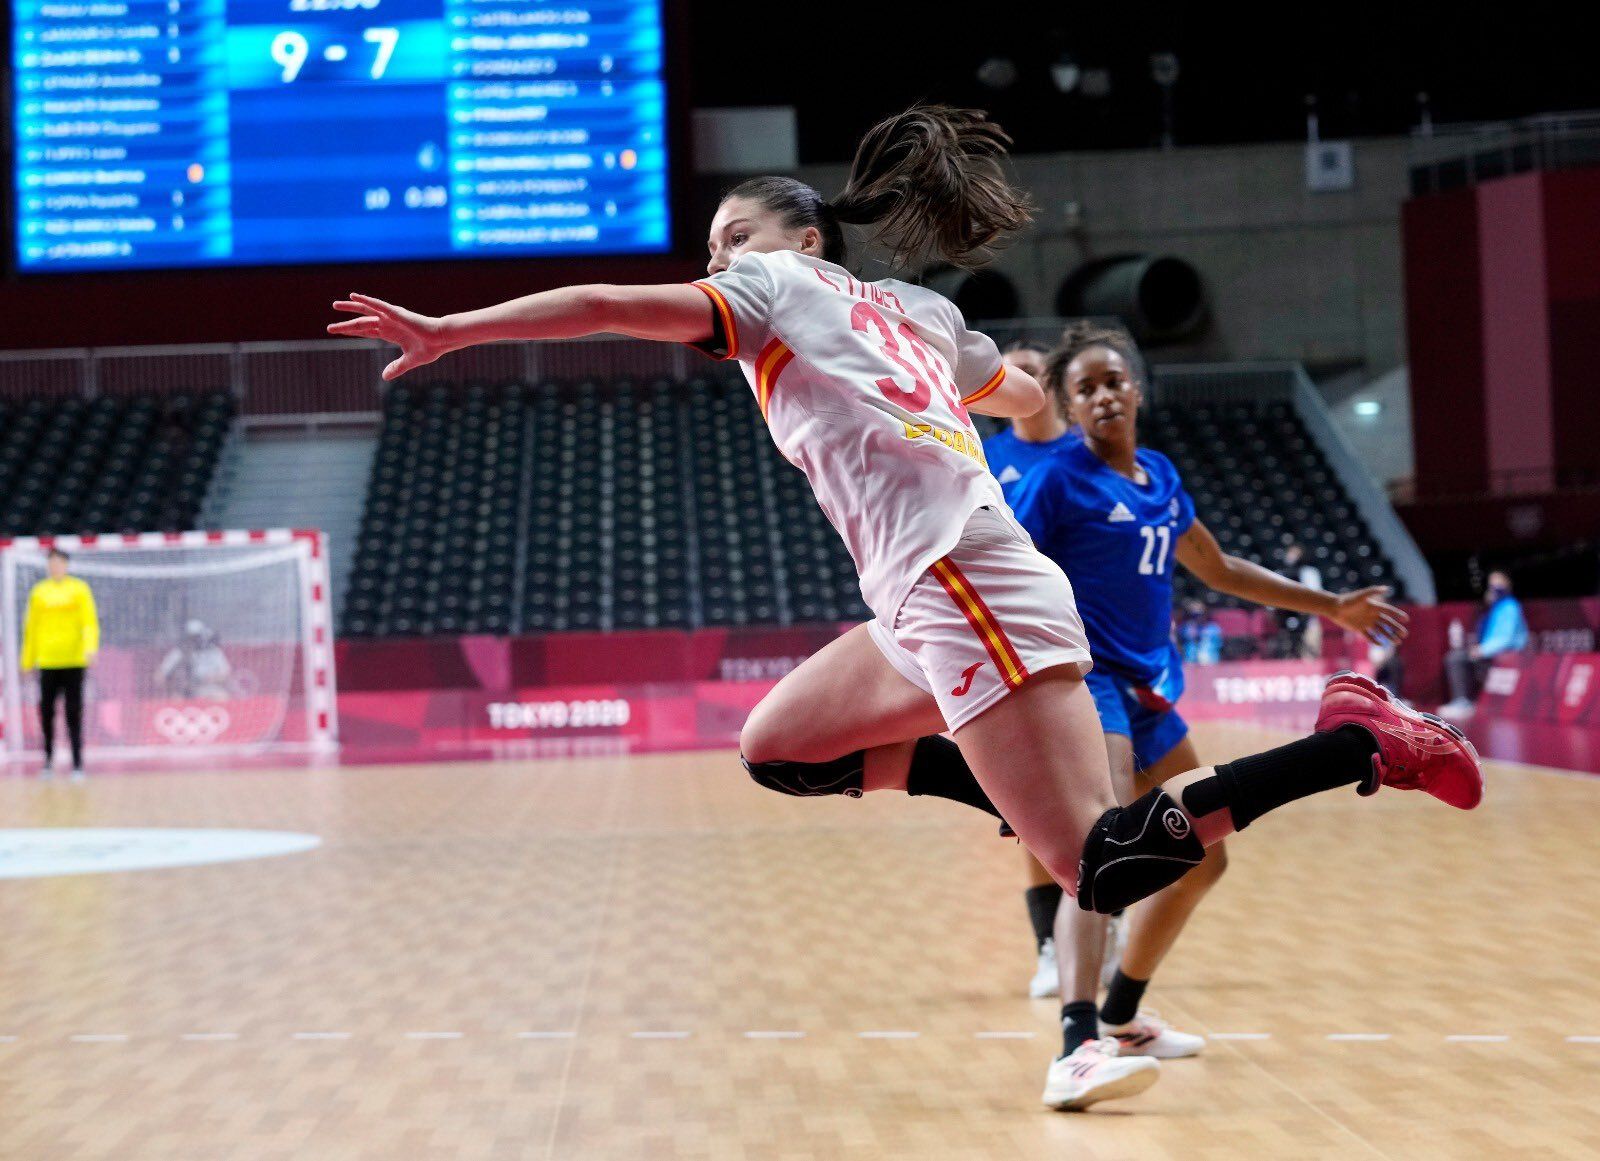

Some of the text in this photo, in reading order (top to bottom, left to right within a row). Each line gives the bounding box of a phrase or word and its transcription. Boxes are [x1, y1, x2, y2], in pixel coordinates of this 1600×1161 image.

[270, 31, 309, 83] 9
[362, 27, 400, 80] 7
[1213, 675, 1327, 703] TOKYO 20
[487, 699, 630, 729] TOKYO 2020
